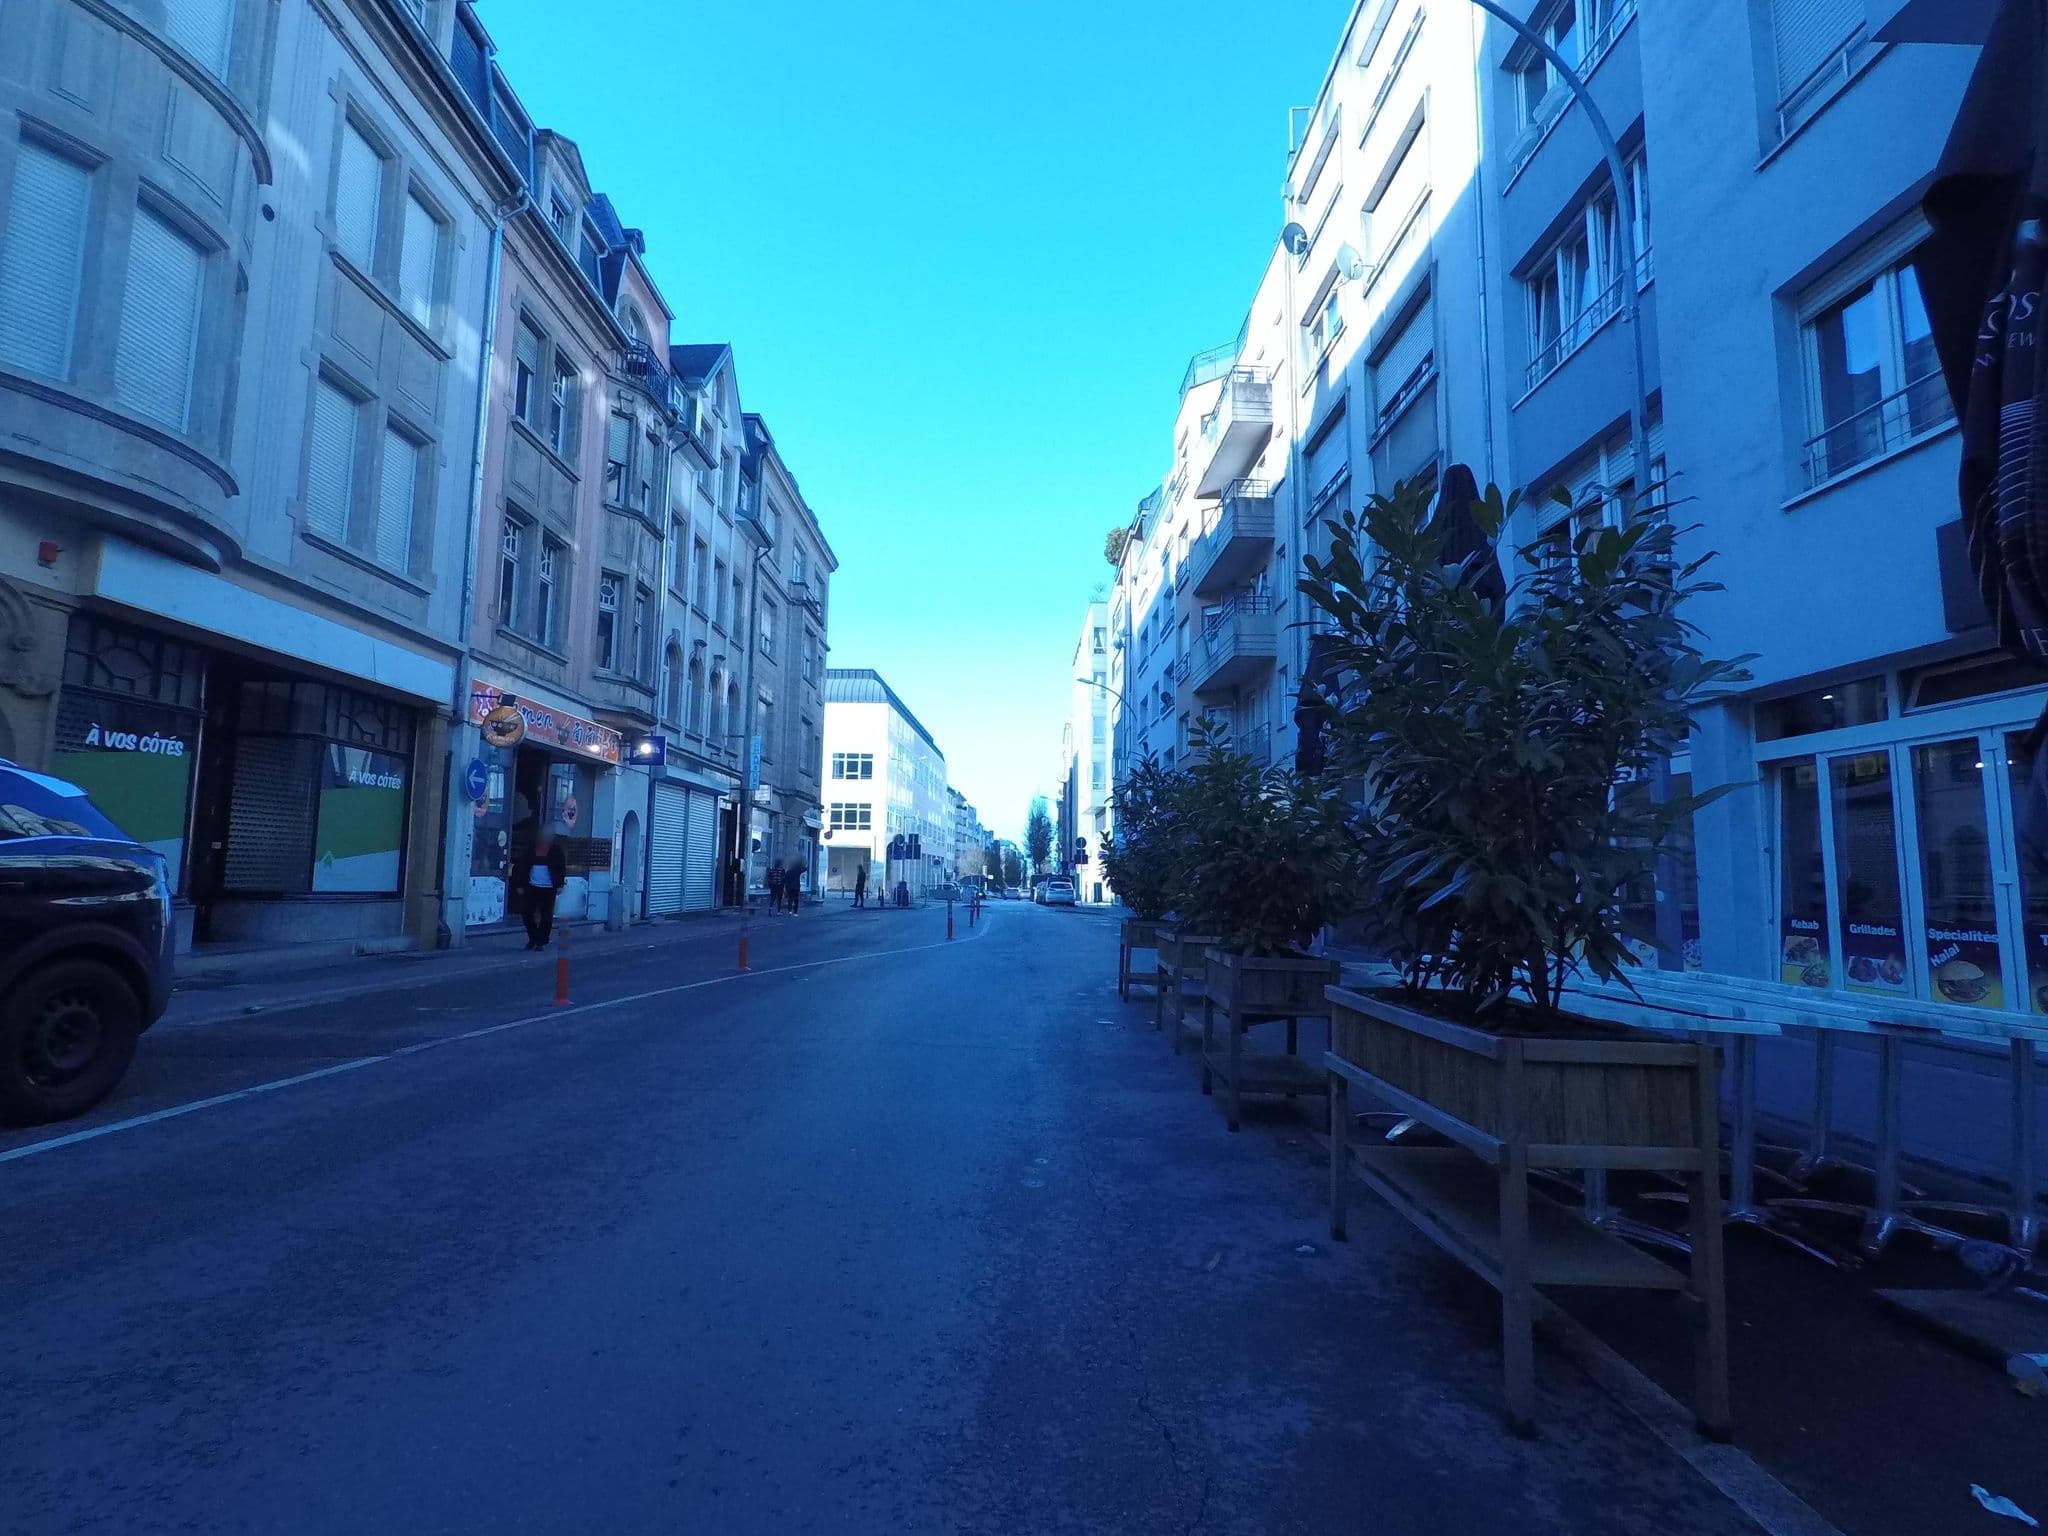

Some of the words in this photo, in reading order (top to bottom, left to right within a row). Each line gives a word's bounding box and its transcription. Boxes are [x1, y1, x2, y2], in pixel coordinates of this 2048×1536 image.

[85, 722, 100, 746] À
[104, 730, 137, 751] VOS
[139, 731, 184, 757] CÔTÉS
[349, 766, 357, 783] À
[359, 771, 377, 786] VOS
[377, 772, 401, 789] CÔTÉS
[1791, 919, 1819, 930] Kebab
[1849, 923, 1897, 936] Grillades
[1928, 928, 2000, 944] Spécialités
[1930, 943, 1960, 967] Halal
